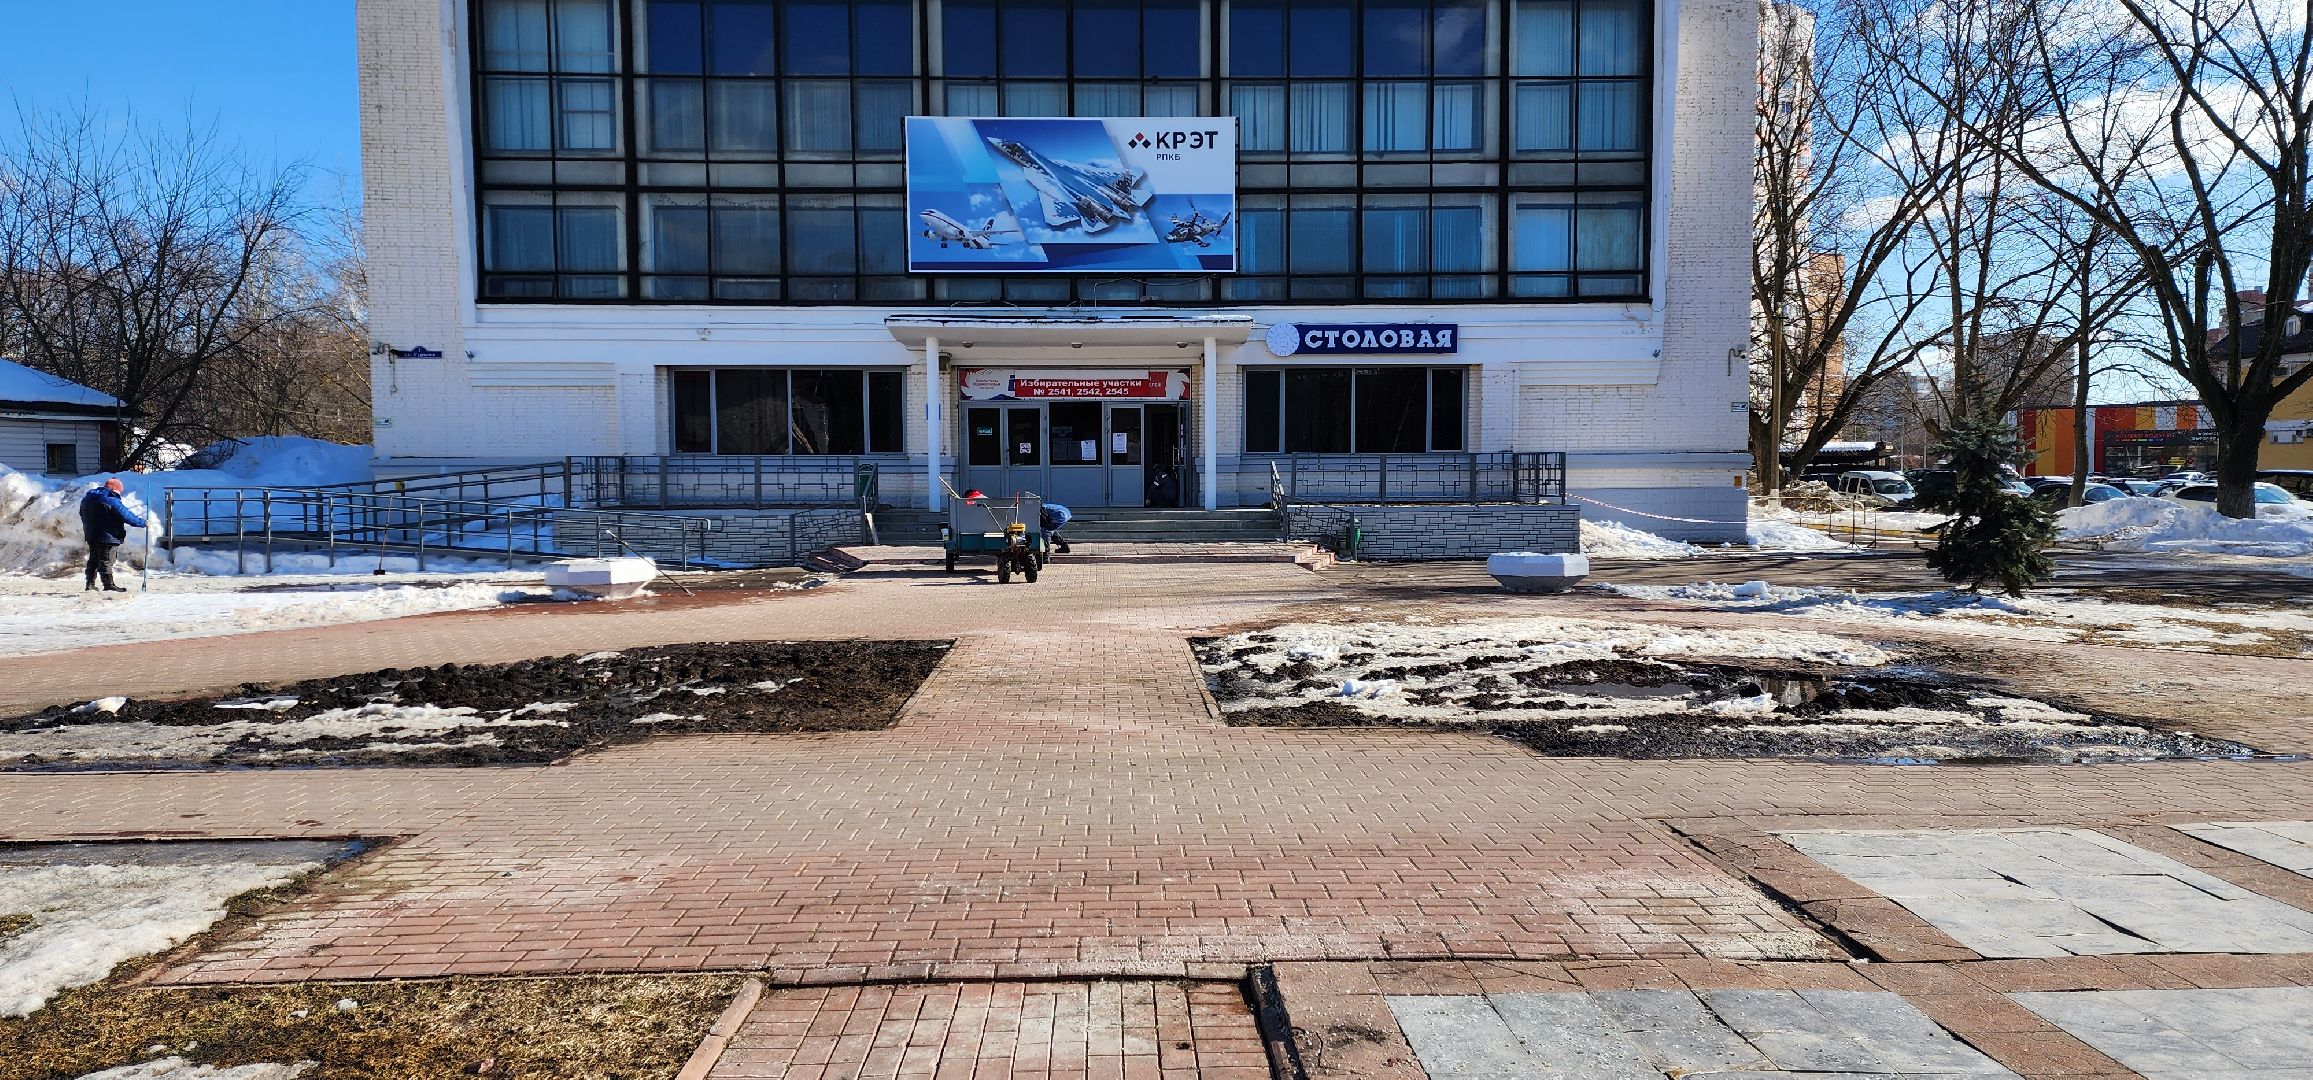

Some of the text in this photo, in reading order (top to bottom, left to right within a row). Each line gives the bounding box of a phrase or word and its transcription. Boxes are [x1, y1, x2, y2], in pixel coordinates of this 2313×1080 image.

[1156, 131, 1219, 149] КРЭТ
[1156, 153, 1181, 161] РПКБ
[1304, 329, 1453, 348] СТОЛОВАЯ
[1020, 379, 1100, 387] Избирательные
[1102, 380, 1142, 388] участки
[1033, 387, 1129, 397] № 2541, 2542, 2545
